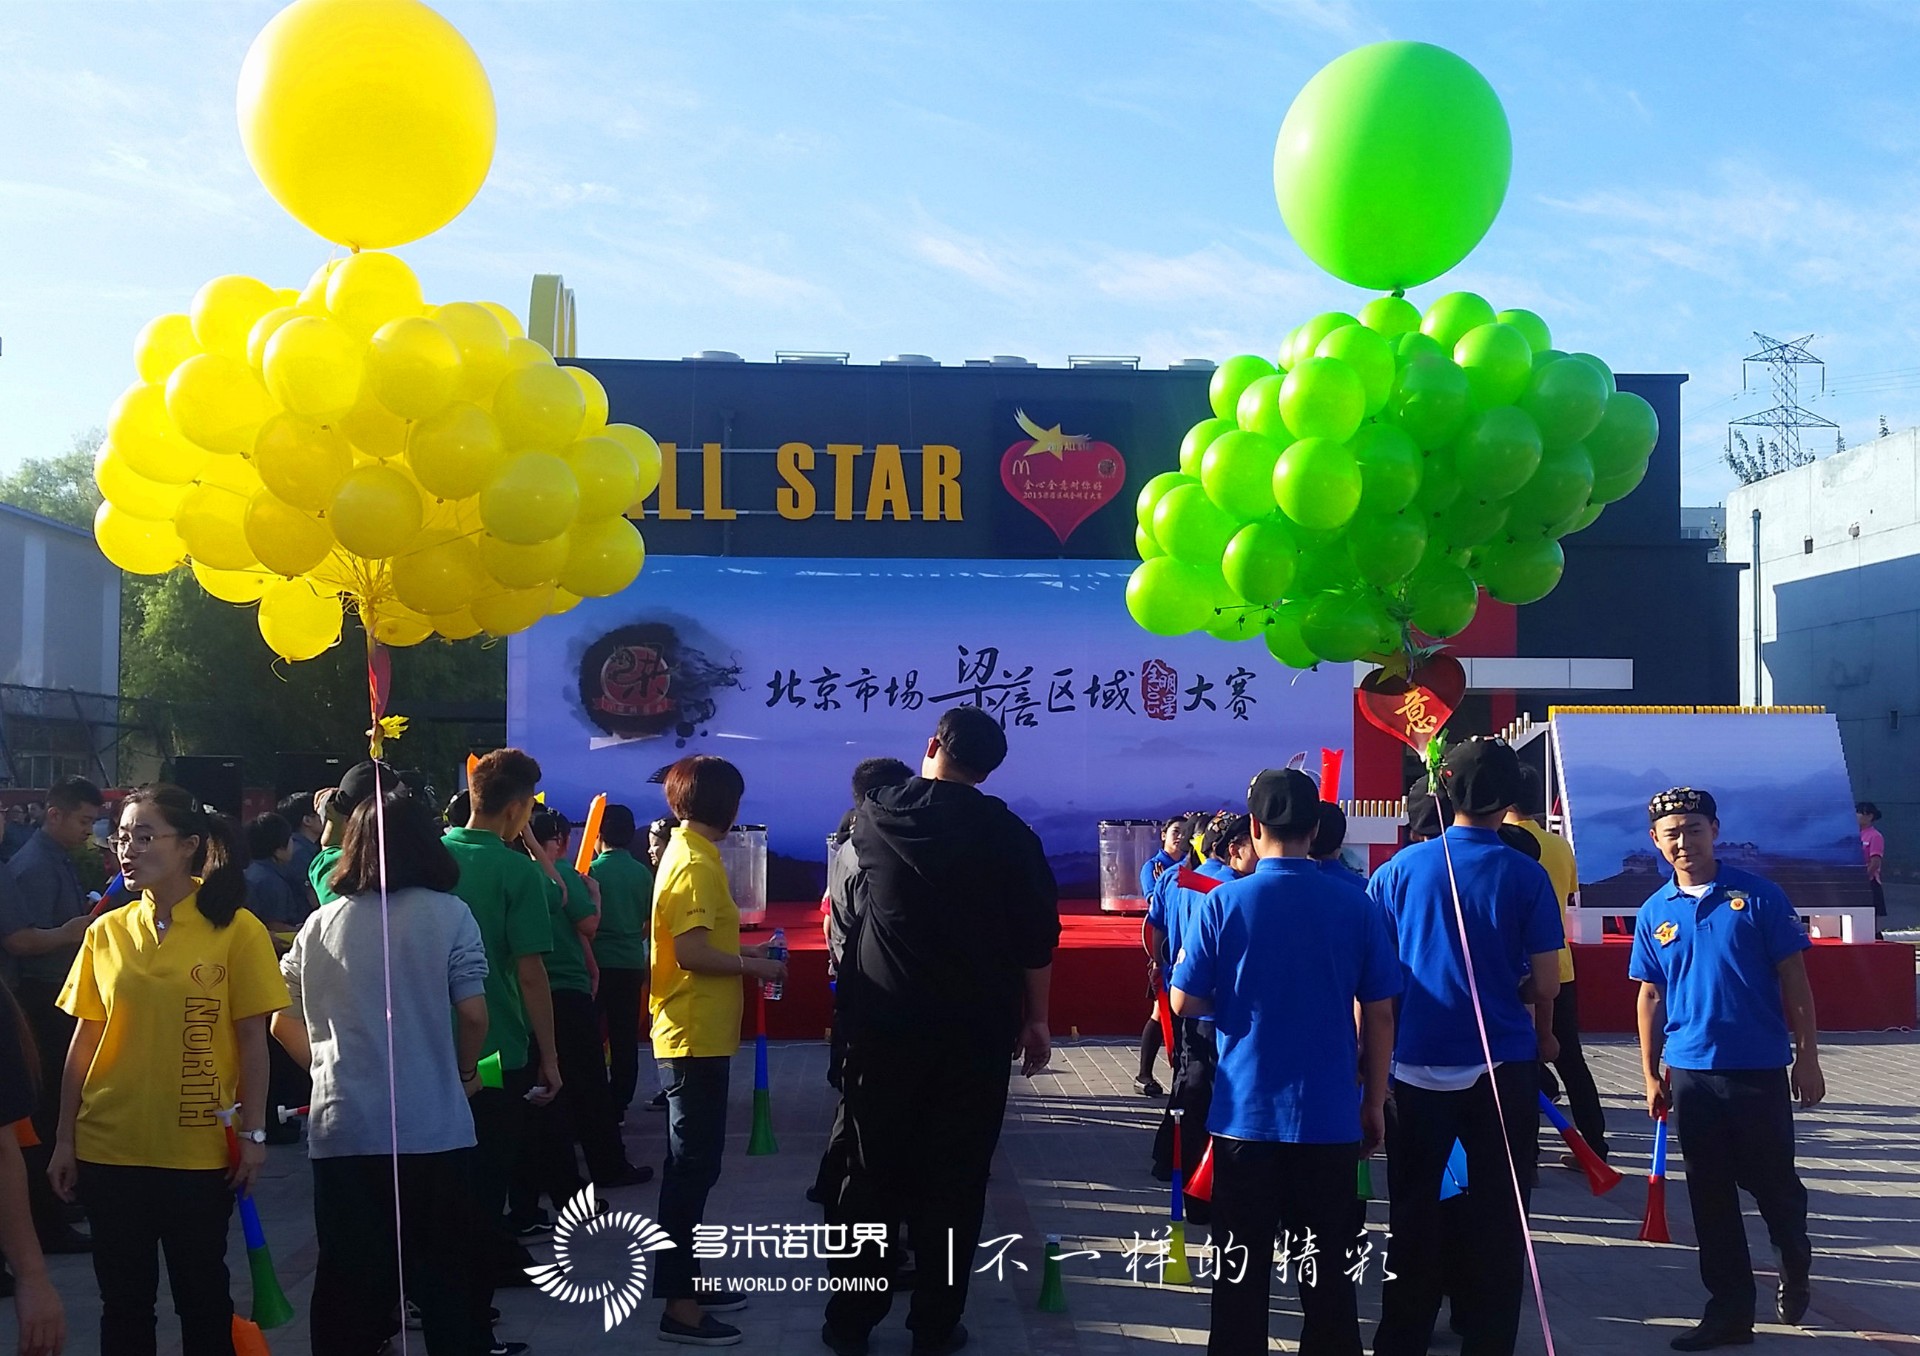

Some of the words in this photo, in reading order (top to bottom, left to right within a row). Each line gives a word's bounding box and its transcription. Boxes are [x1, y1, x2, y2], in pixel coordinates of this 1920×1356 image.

[623, 442, 737, 520] LL
[776, 442, 964, 521] STAR
[1183, 666, 1258, 721] 大赛
[1394, 686, 1438, 738] 意
[179, 996, 221, 1127] NORTH
